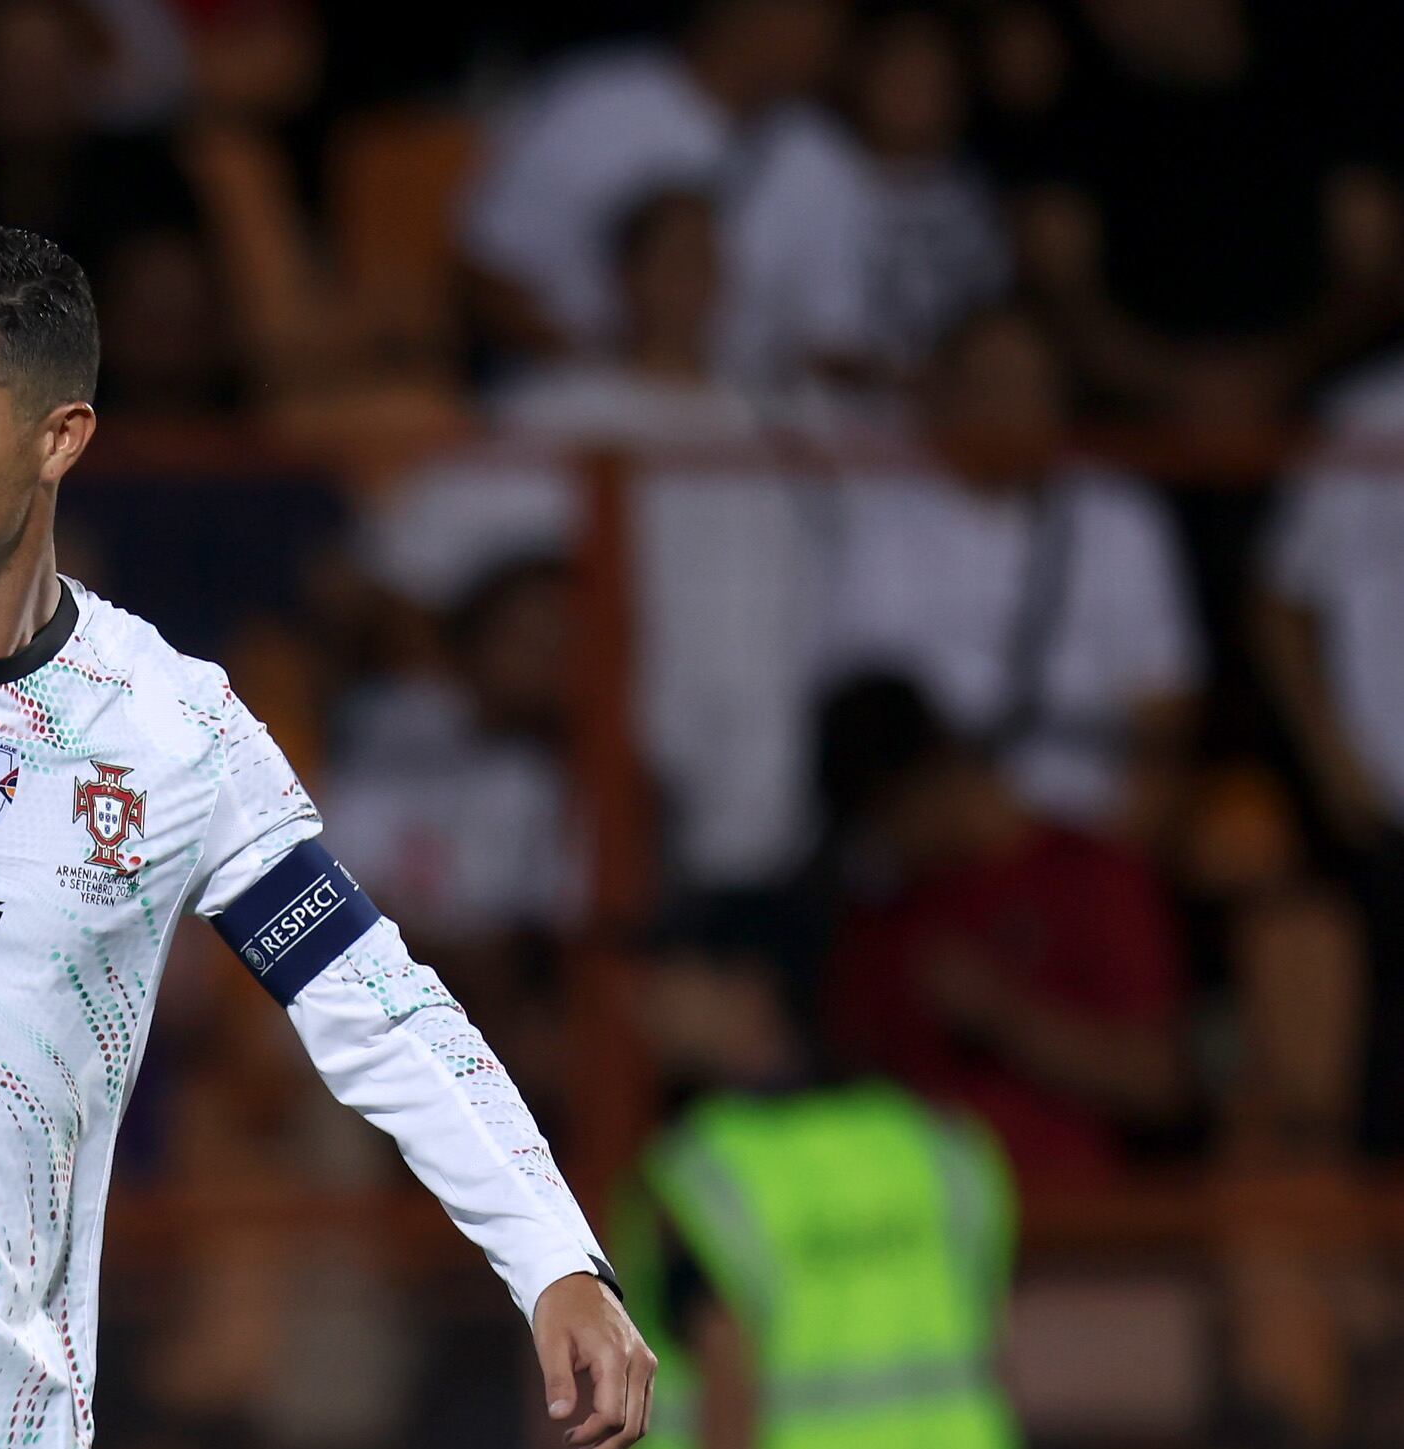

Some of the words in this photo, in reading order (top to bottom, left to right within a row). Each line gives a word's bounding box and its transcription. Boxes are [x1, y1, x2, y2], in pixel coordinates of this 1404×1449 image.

[60, 878, 66, 888] 6
[69, 878, 113, 896] SETEMBRO
[80, 891, 116, 907] YEREVAN
[260, 880, 339, 955] RESPECT
